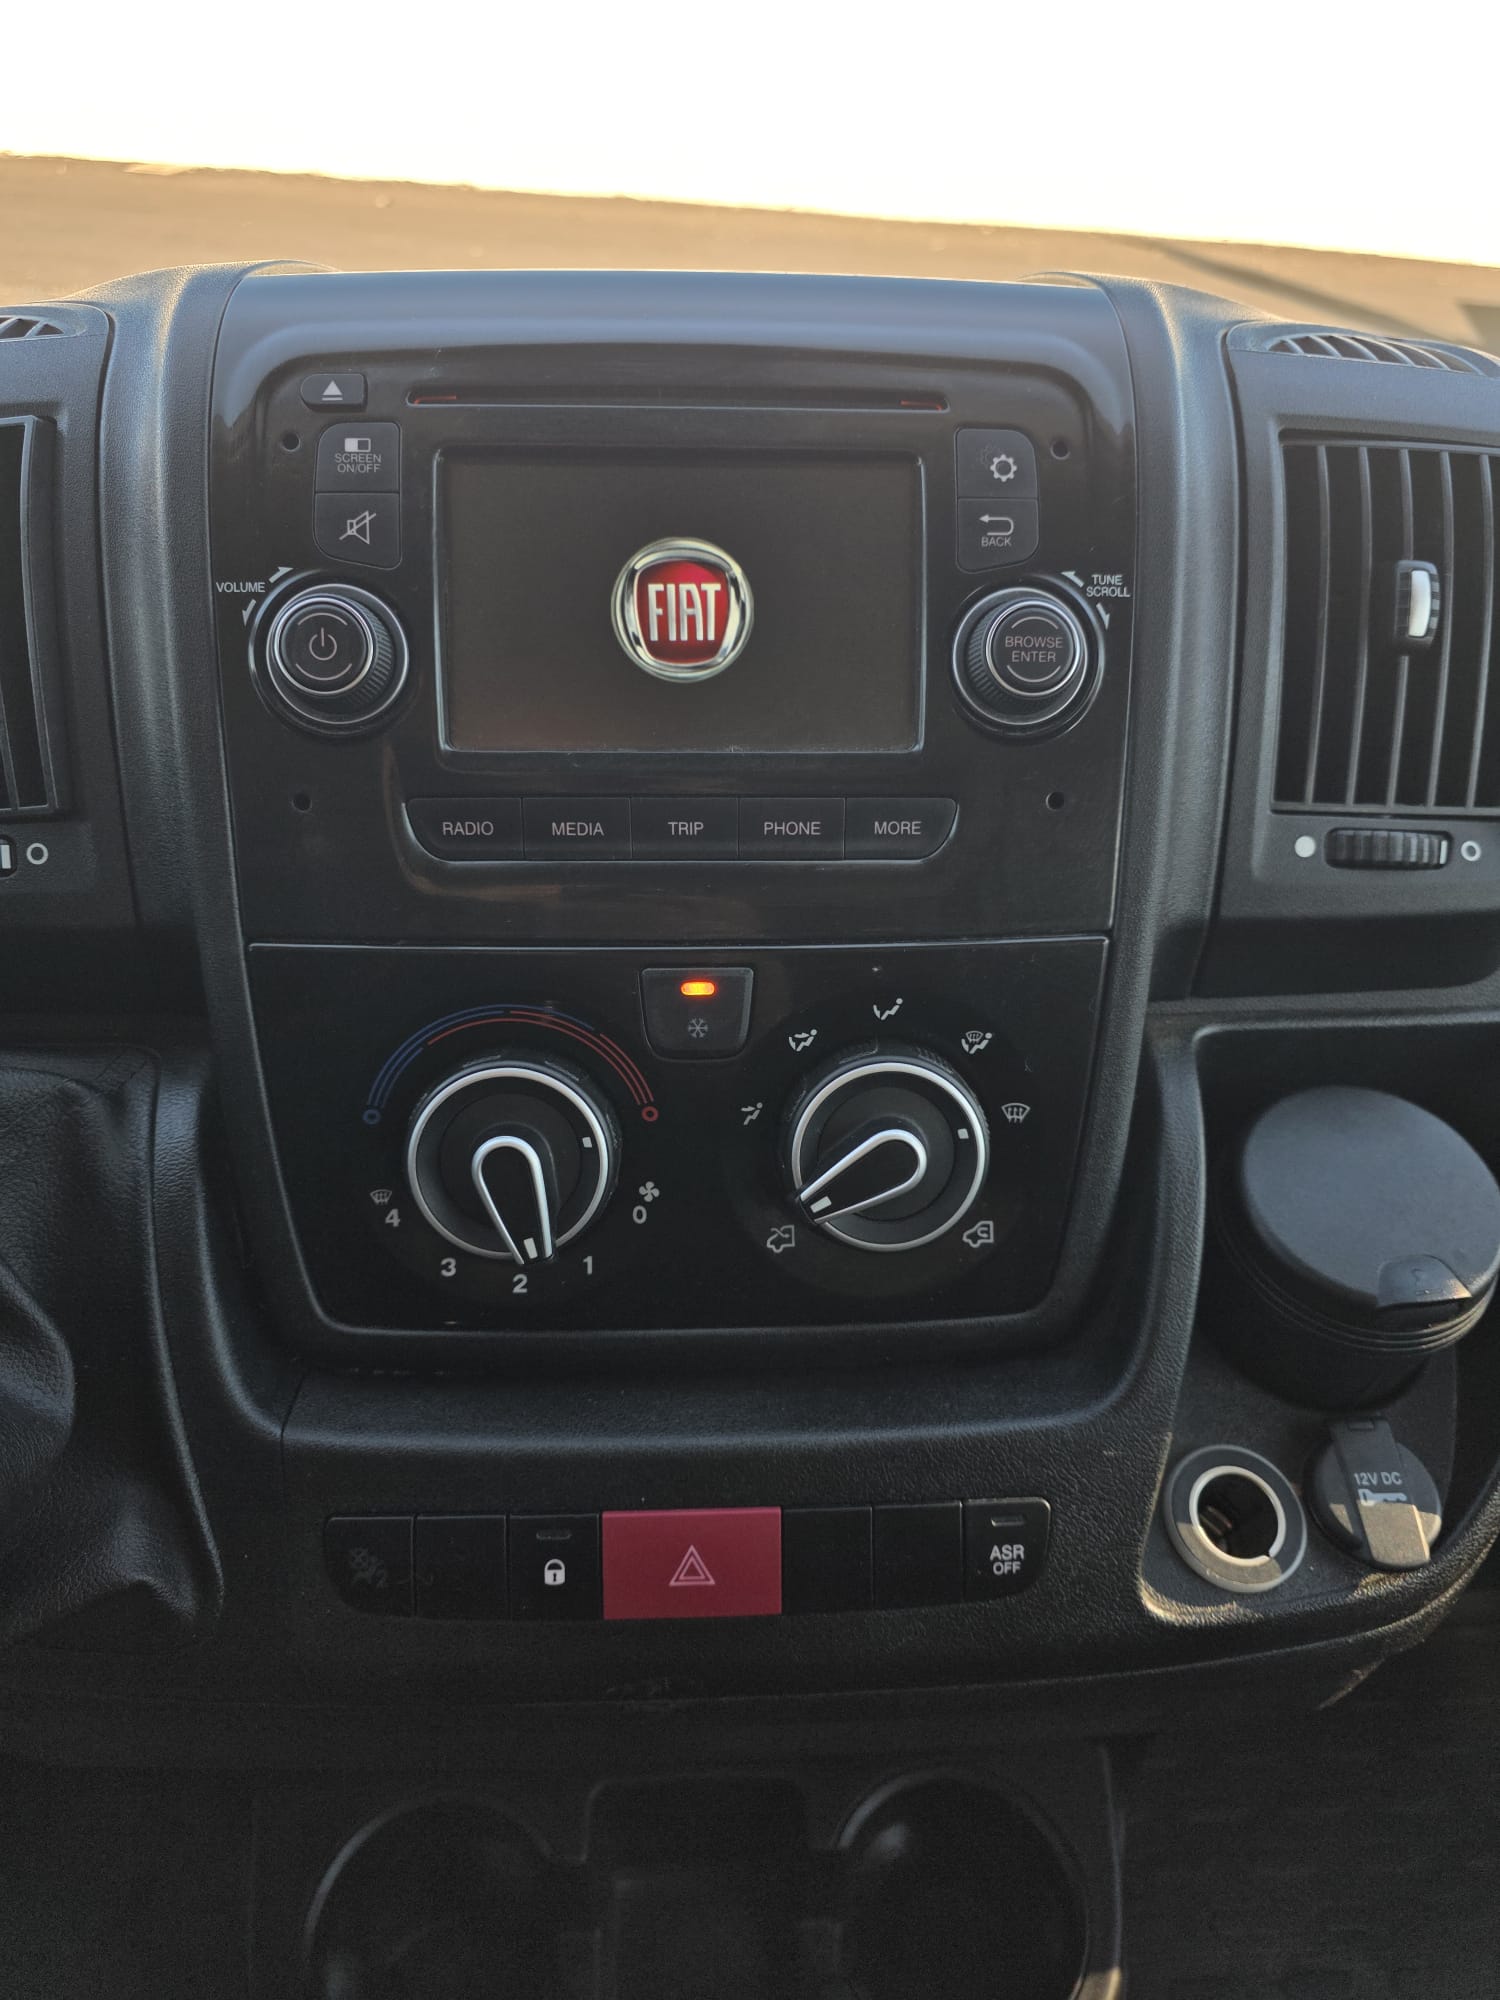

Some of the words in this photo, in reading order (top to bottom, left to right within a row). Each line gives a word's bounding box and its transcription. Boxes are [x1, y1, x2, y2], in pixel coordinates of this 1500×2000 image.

[334, 453, 382, 463] SCREEN
[337, 463, 381, 473] ON/OFF
[981, 536, 1012, 547] BACK
[216, 582, 266, 593] VOLUME
[1091, 574, 1123, 586] TUNE
[1086, 586, 1131, 598] SCROLL
[648, 583, 721, 642] FIAT
[1005, 635, 1063, 649] BROWSE
[1011, 651, 1057, 663] ENTER
[442, 821, 494, 836] RADIO
[551, 822, 605, 836] MEDIA
[668, 821, 704, 836] TRIP
[763, 821, 821, 836] PHONE
[874, 820, 922, 836] MORE
[385, 1208, 401, 1228] 4
[632, 1205, 648, 1224] 0
[440, 1257, 457, 1277] 3
[582, 1255, 593, 1275] 1
[512, 1274, 528, 1293] 2
[1354, 1472, 1377, 1486] 12V
[1380, 1471, 1403, 1486] DC
[989, 1544, 1025, 1561] ASR
[992, 1561, 1021, 1576] OFF
